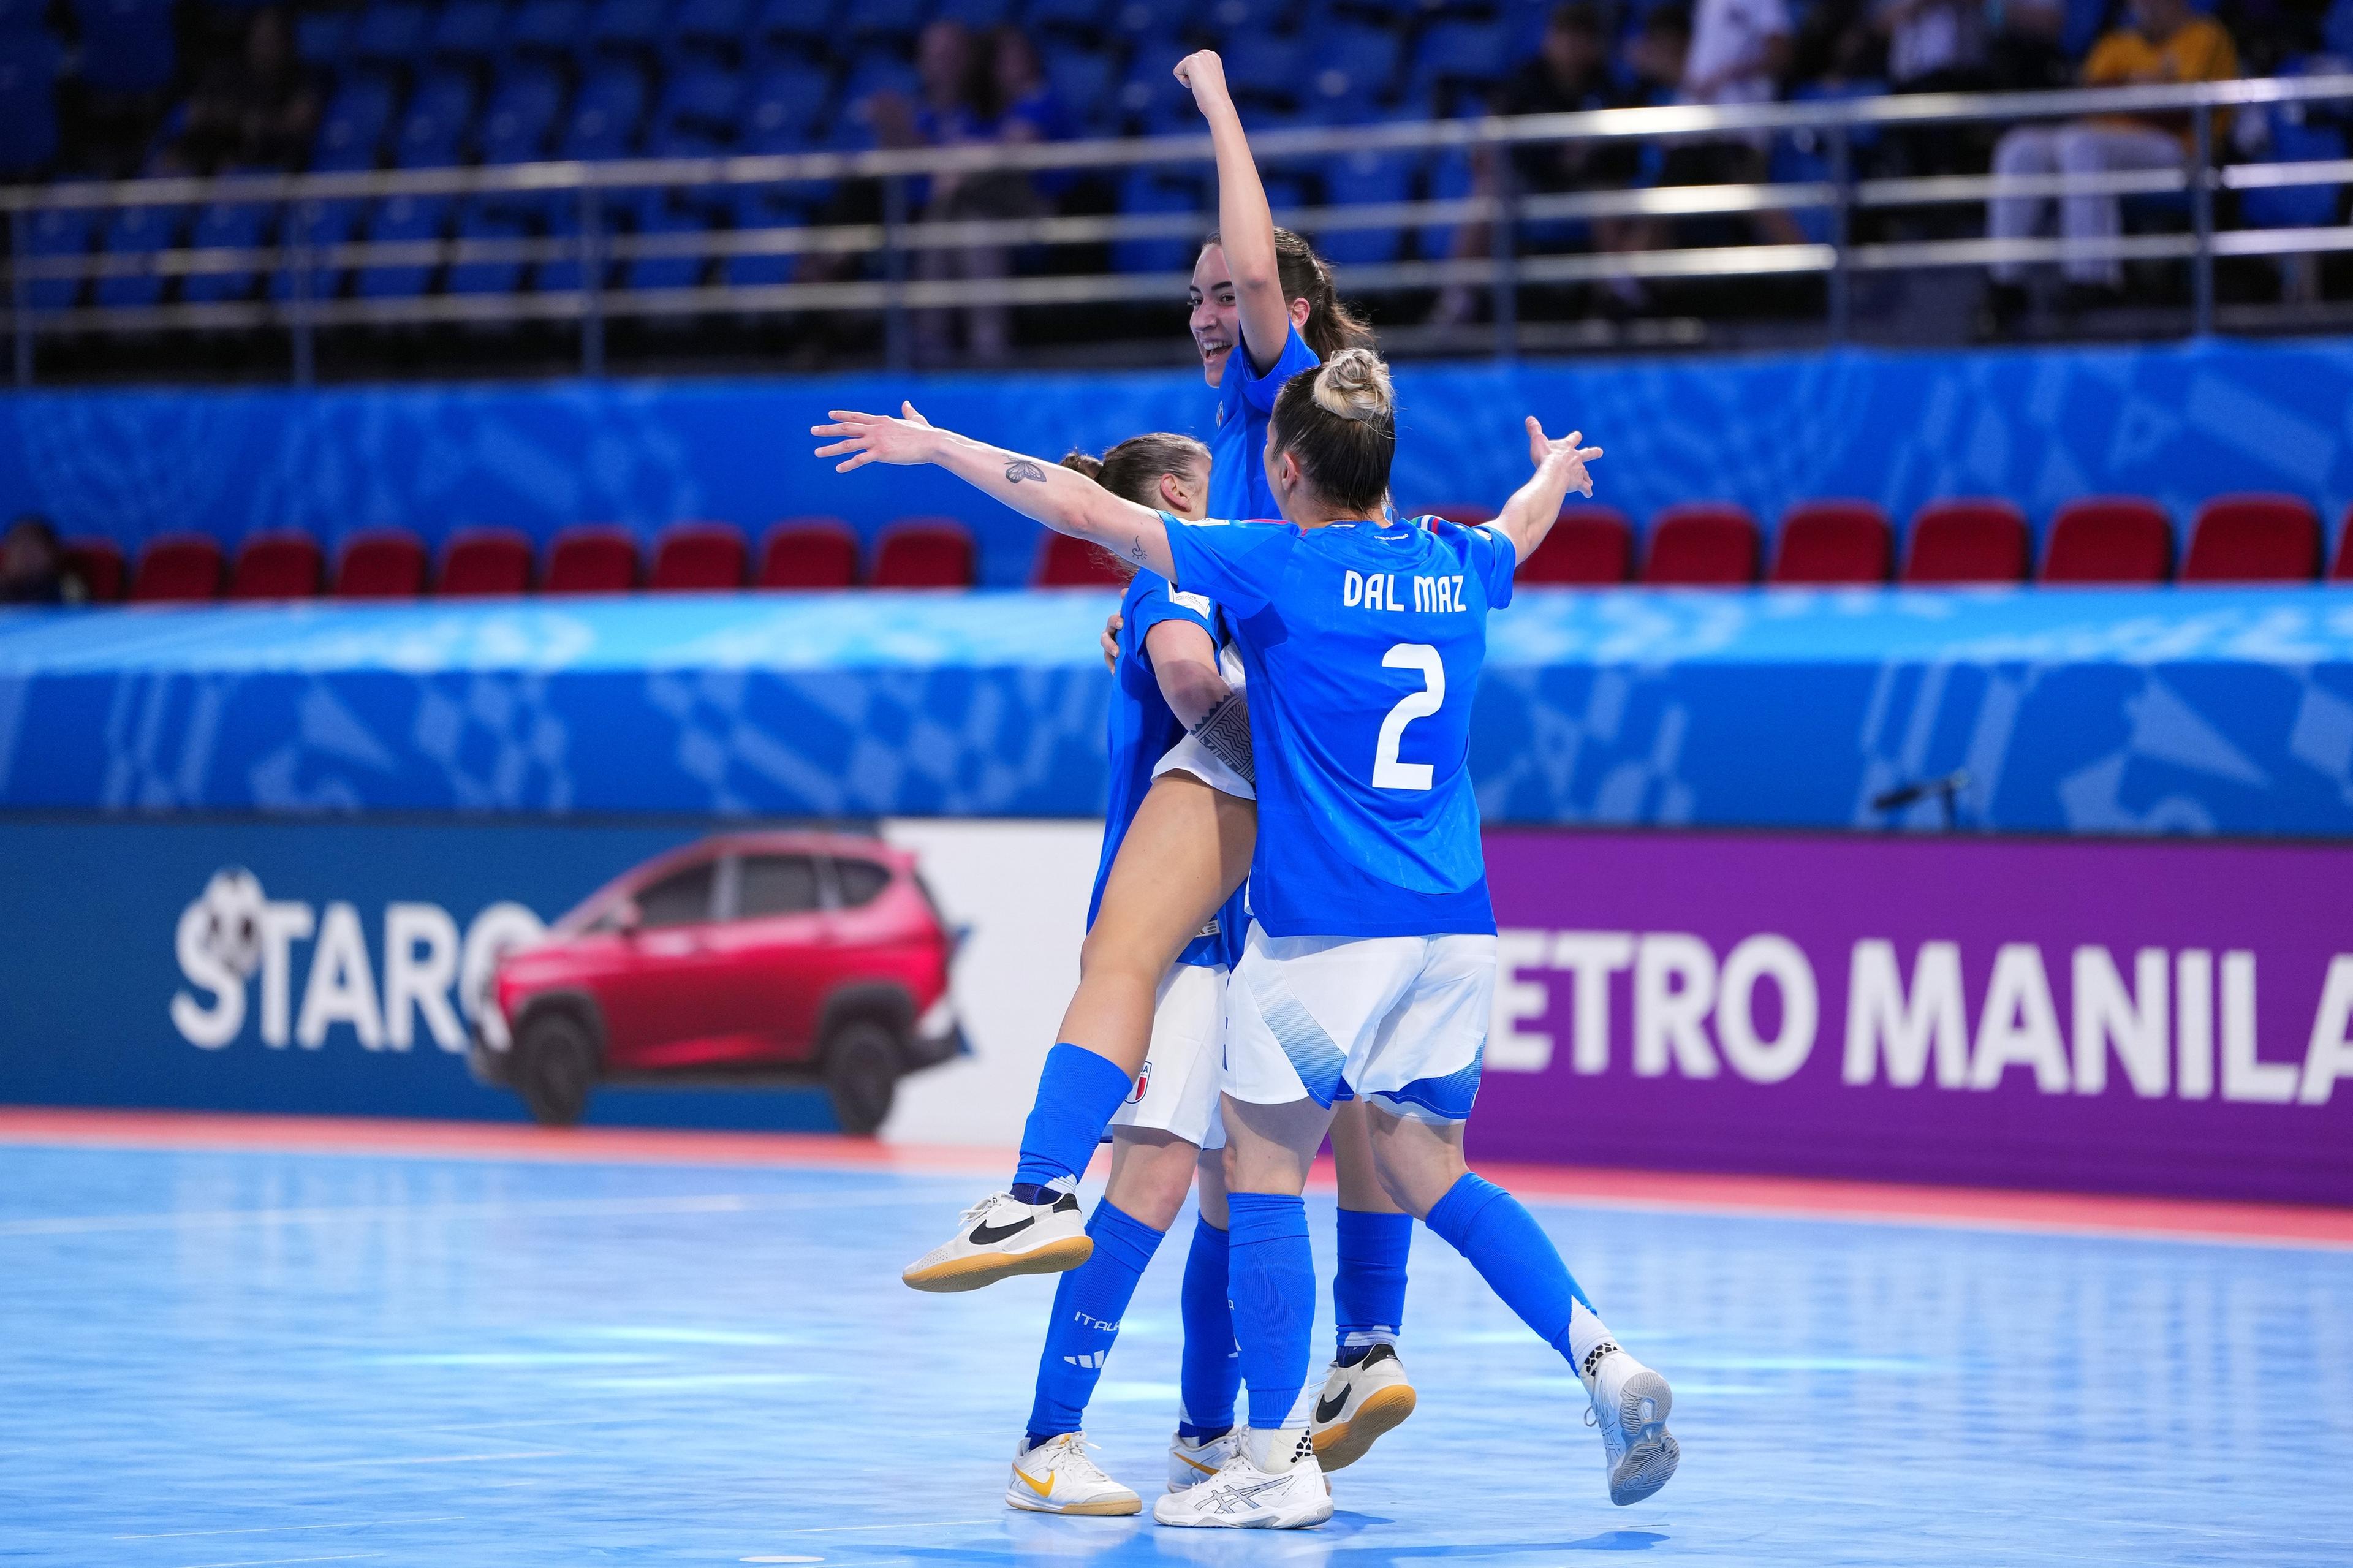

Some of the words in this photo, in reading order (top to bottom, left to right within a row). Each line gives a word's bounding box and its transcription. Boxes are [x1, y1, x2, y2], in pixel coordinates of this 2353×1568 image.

[1343, 570, 1404, 612] DAL
[1414, 575, 1467, 613] MAZ
[1372, 643, 1446, 790] 2
